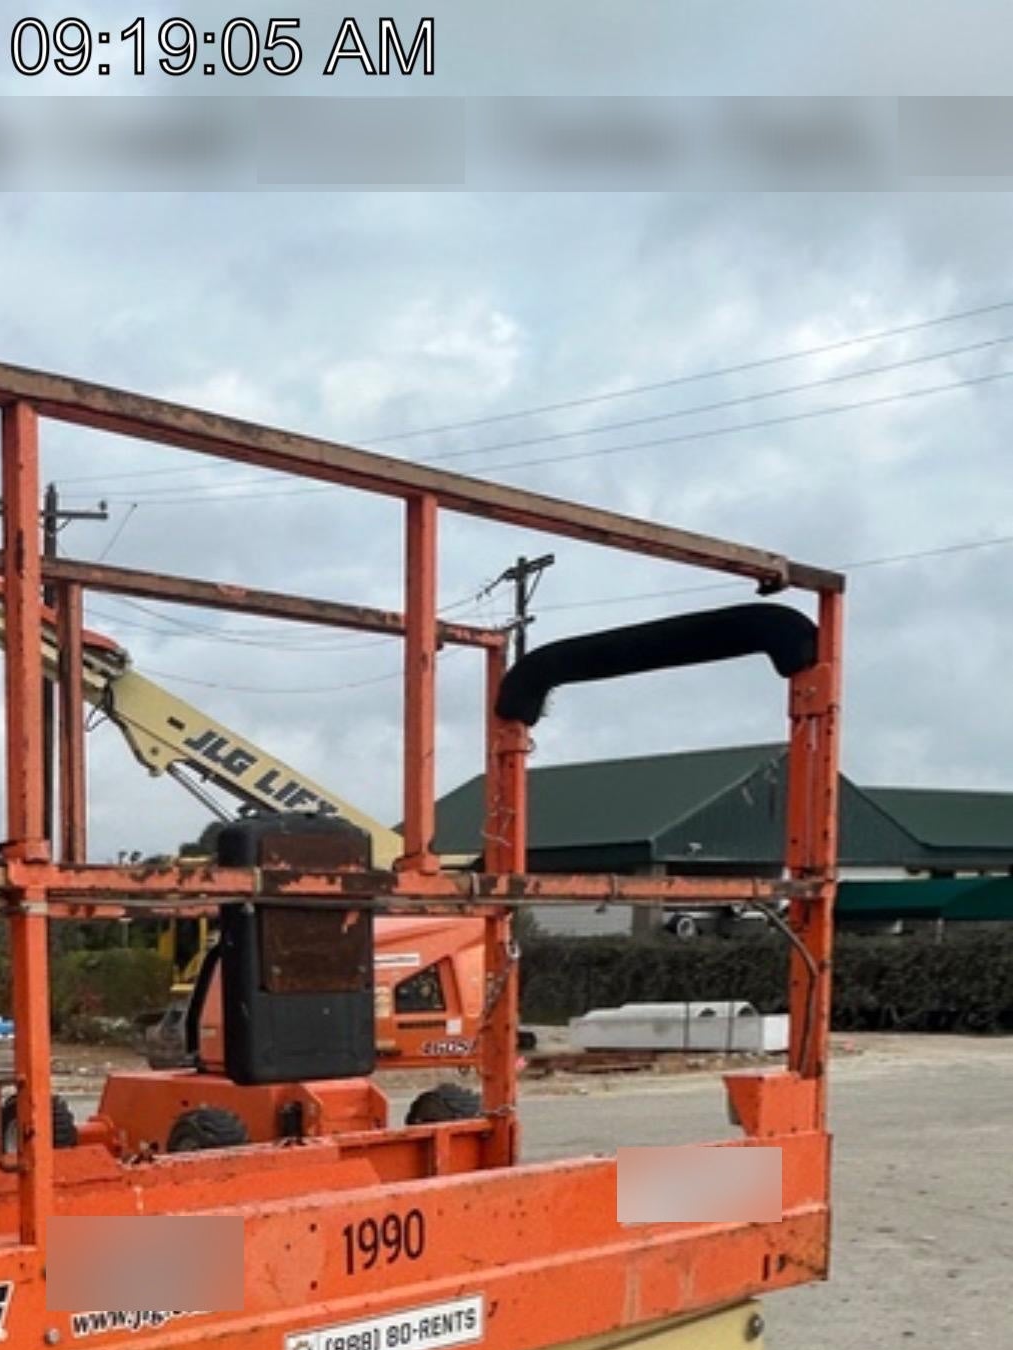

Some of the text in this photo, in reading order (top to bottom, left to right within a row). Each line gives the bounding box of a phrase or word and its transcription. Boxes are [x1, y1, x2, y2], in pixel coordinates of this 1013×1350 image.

[183, 729, 259, 777] JLG
[343, 1208, 425, 1275] 1990
[386, 1307, 477, 1348] 80-RENTS
